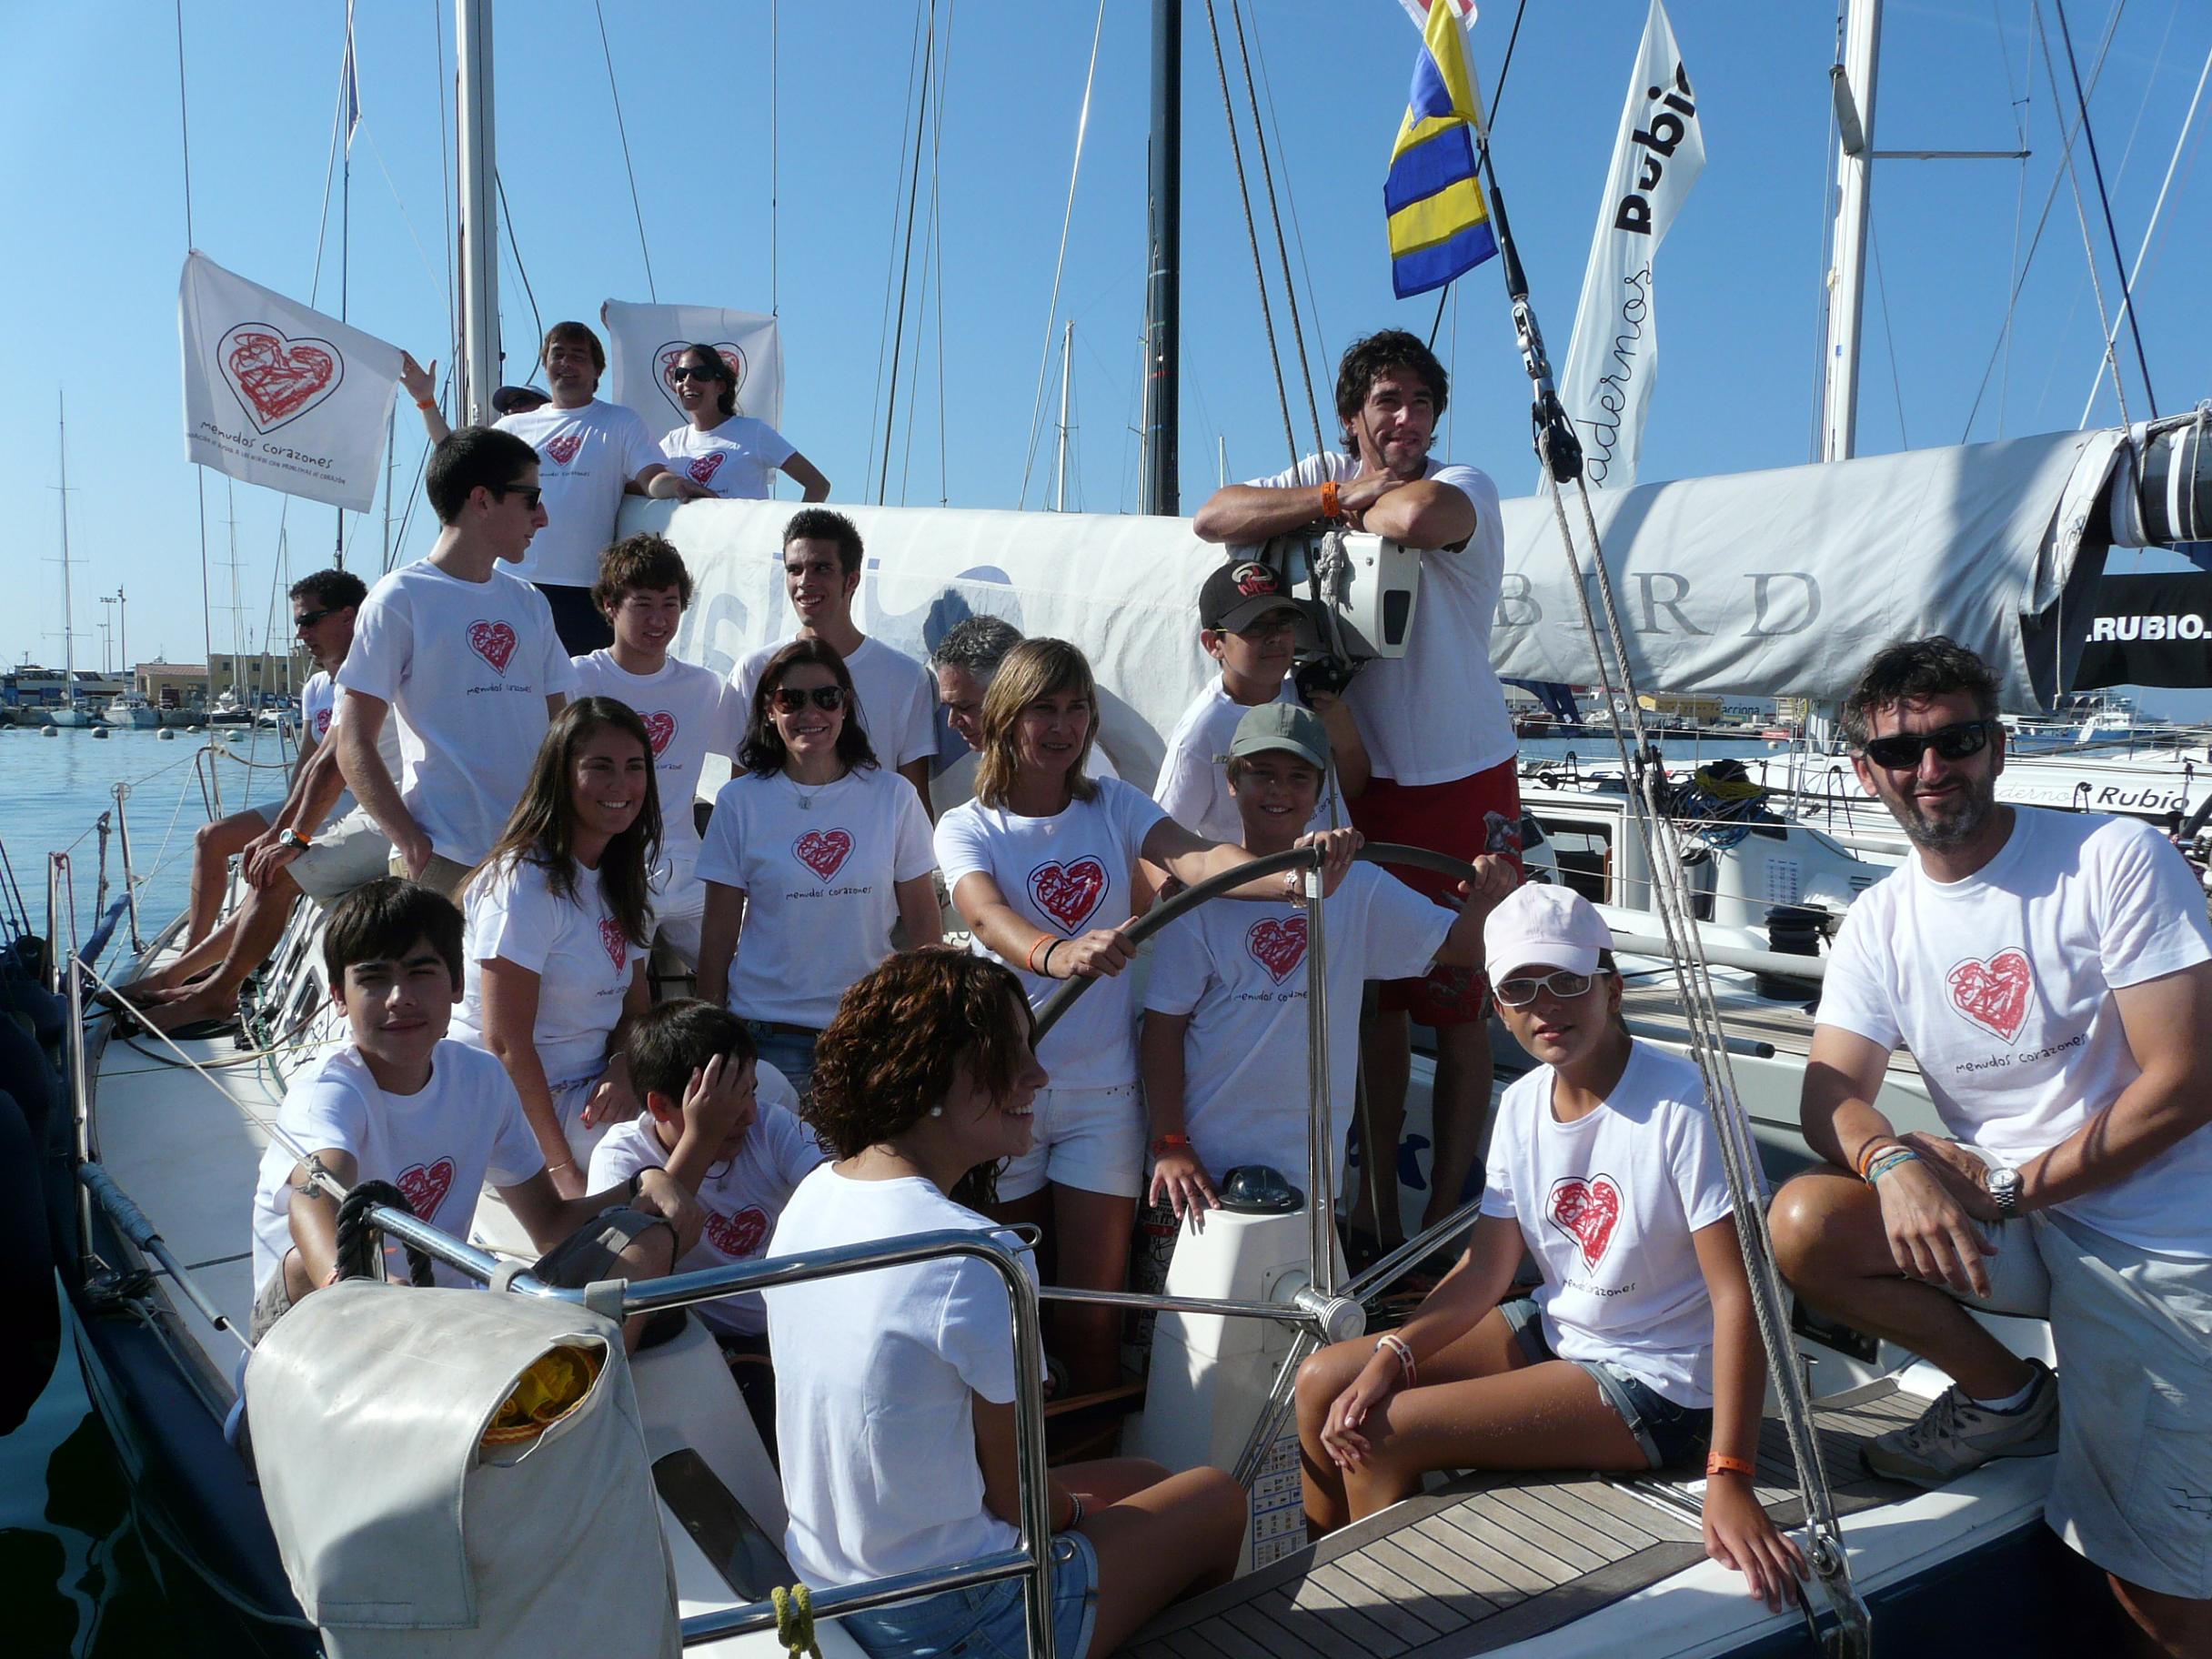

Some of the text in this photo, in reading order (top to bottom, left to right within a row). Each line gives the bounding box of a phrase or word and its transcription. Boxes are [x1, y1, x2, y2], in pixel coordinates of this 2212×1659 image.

[200, 420, 256, 448] menudos
[262, 442, 334, 469] corazones
[2096, 786, 2190, 810] Rubio
[786, 886, 872, 900] menudos corazones
[1956, 1032, 2086, 1073] menudos corazones
